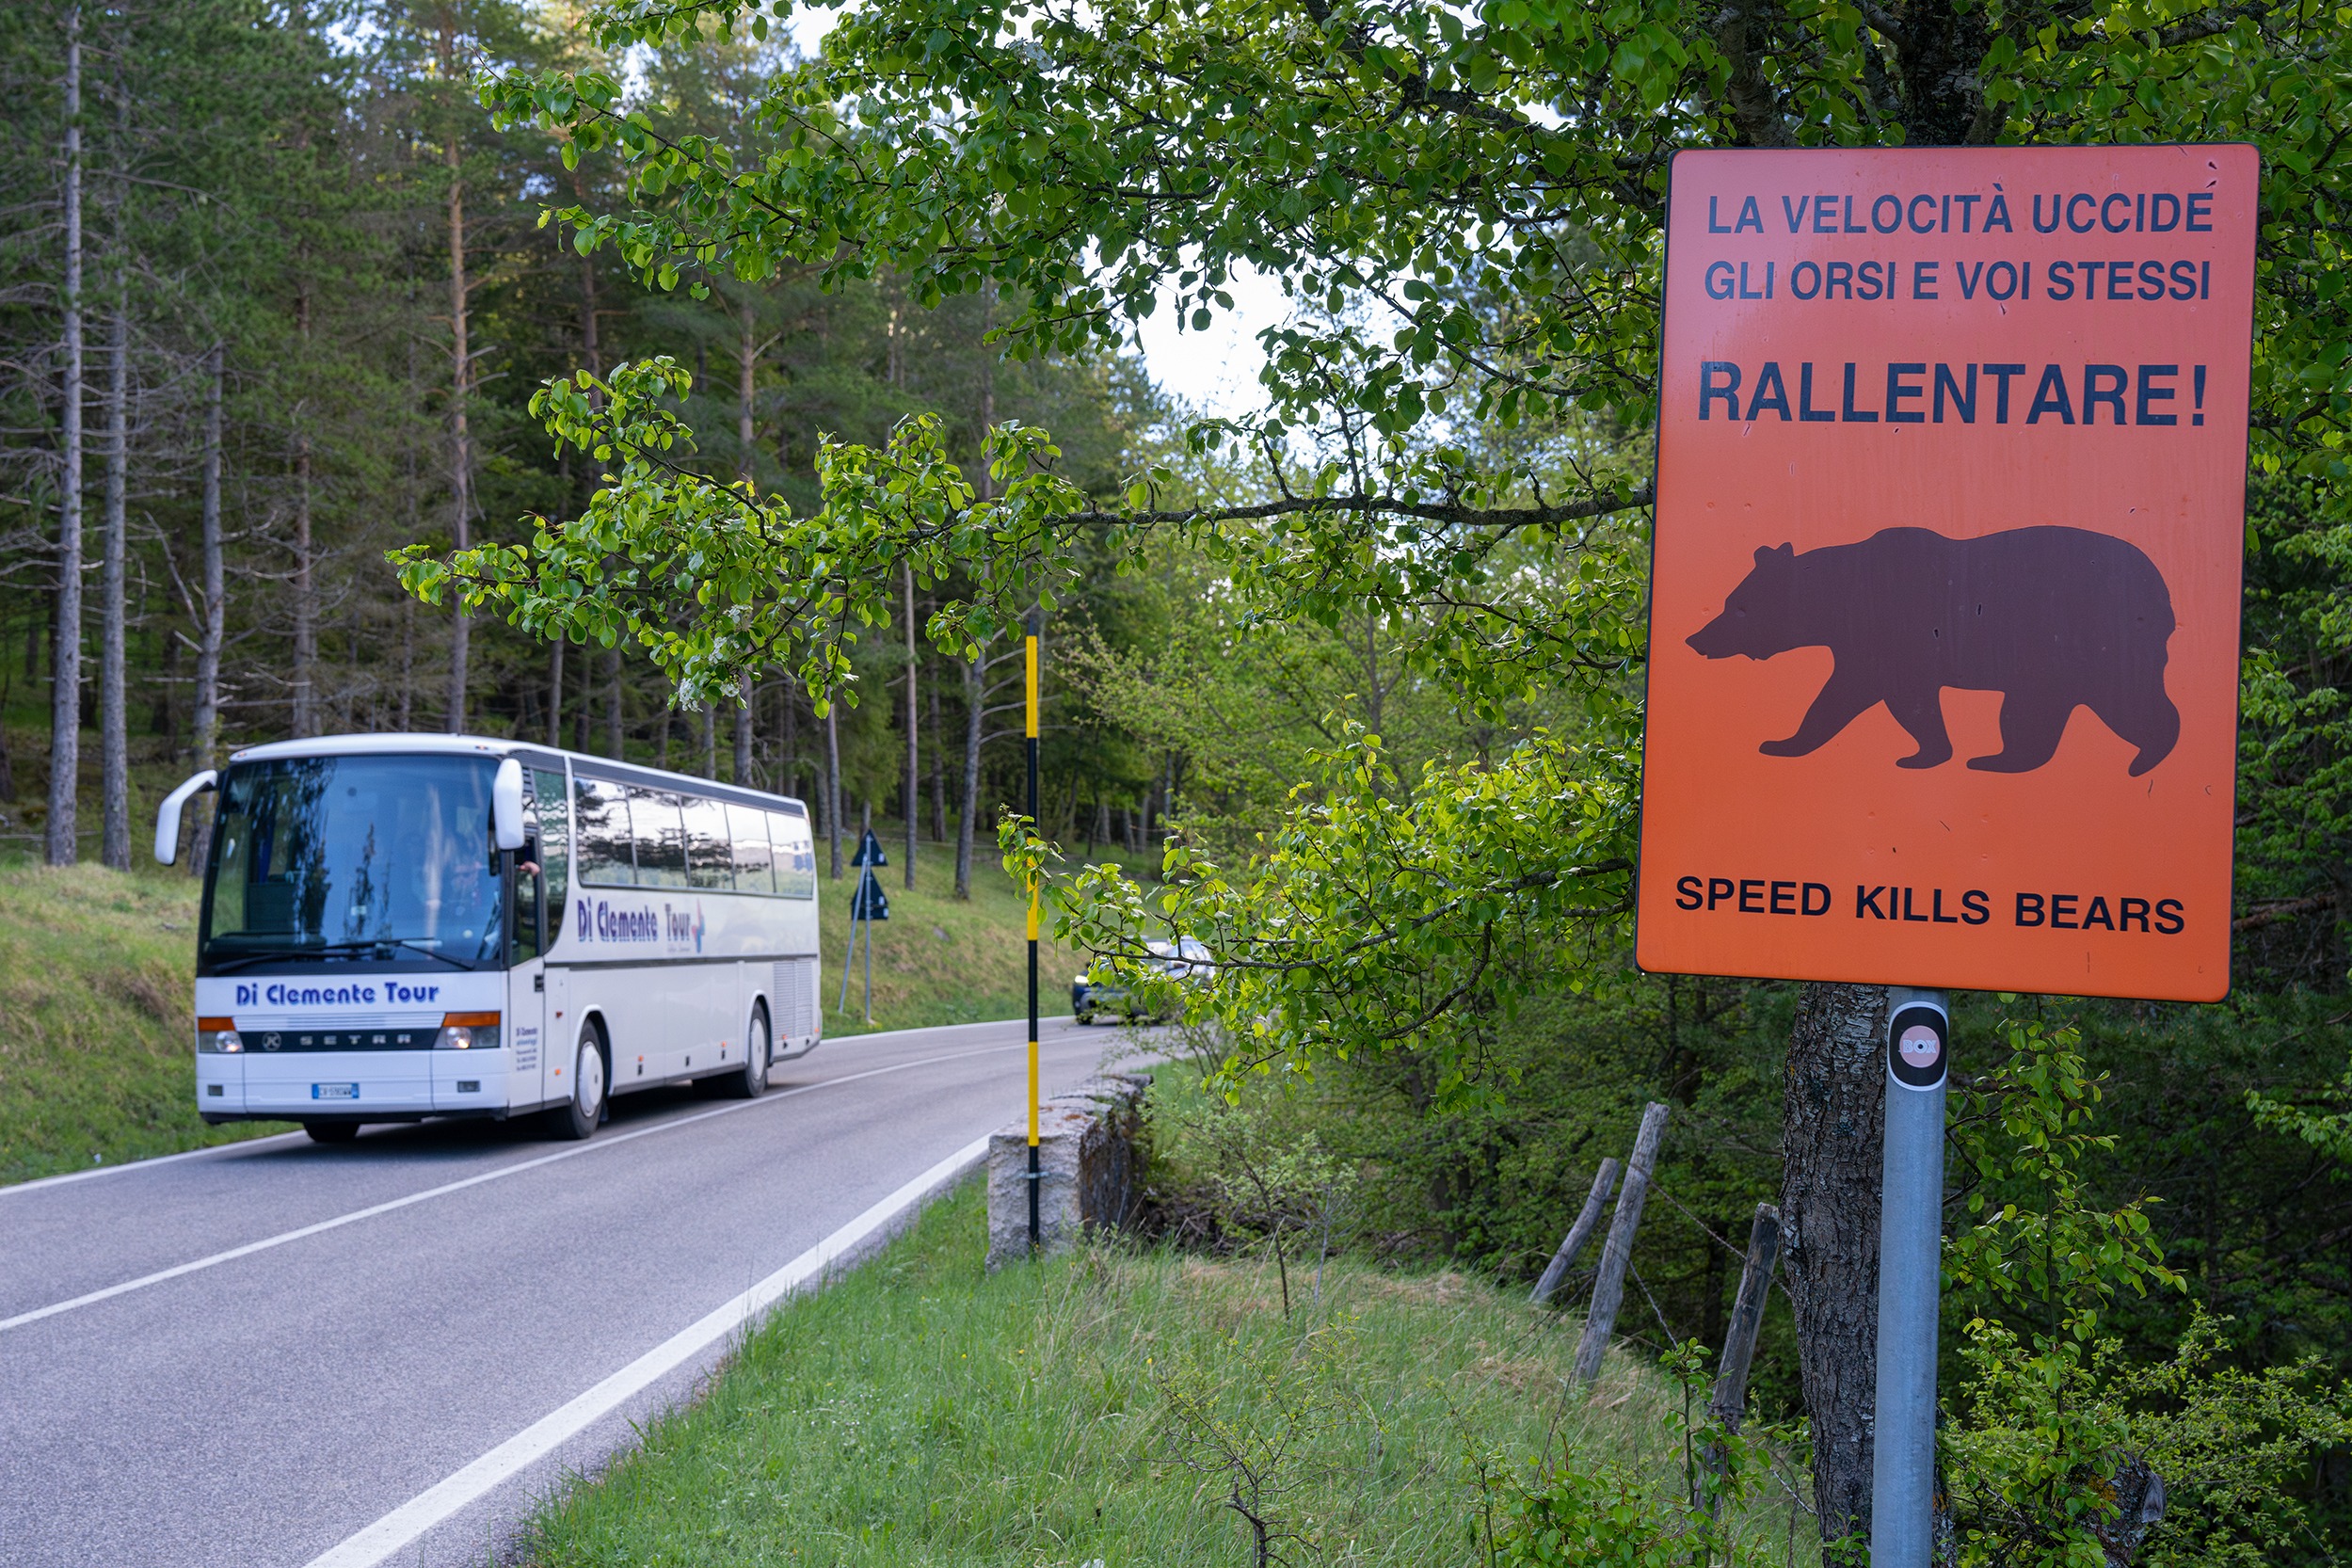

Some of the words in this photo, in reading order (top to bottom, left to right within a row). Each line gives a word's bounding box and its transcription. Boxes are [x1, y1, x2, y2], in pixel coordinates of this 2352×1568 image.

[1707, 195, 1765, 234] LA
[1781, 184, 2013, 234] VELOCITÀ
[2032, 192, 2214, 233] UCCIDE
[1704, 261, 1773, 300] GLI
[1790, 261, 1894, 300] ORSI
[1912, 261, 1938, 300] E
[1956, 261, 2030, 300] VOI
[2046, 260, 2209, 301] STESSI
[1698, 361, 2207, 426] RALLENTARE!
[578, 897, 593, 941] Di
[597, 900, 657, 941] Clemente
[664, 903, 690, 941] Tour
[1674, 876, 1832, 917] SPEED
[1854, 885, 1991, 926] KILLS
[2014, 892, 2186, 936] BEARS
[236, 983, 258, 1006] Di
[266, 984, 376, 1005] Clemente
[384, 982, 440, 1003] Tour
[1902, 1039, 1937, 1053] BOX
